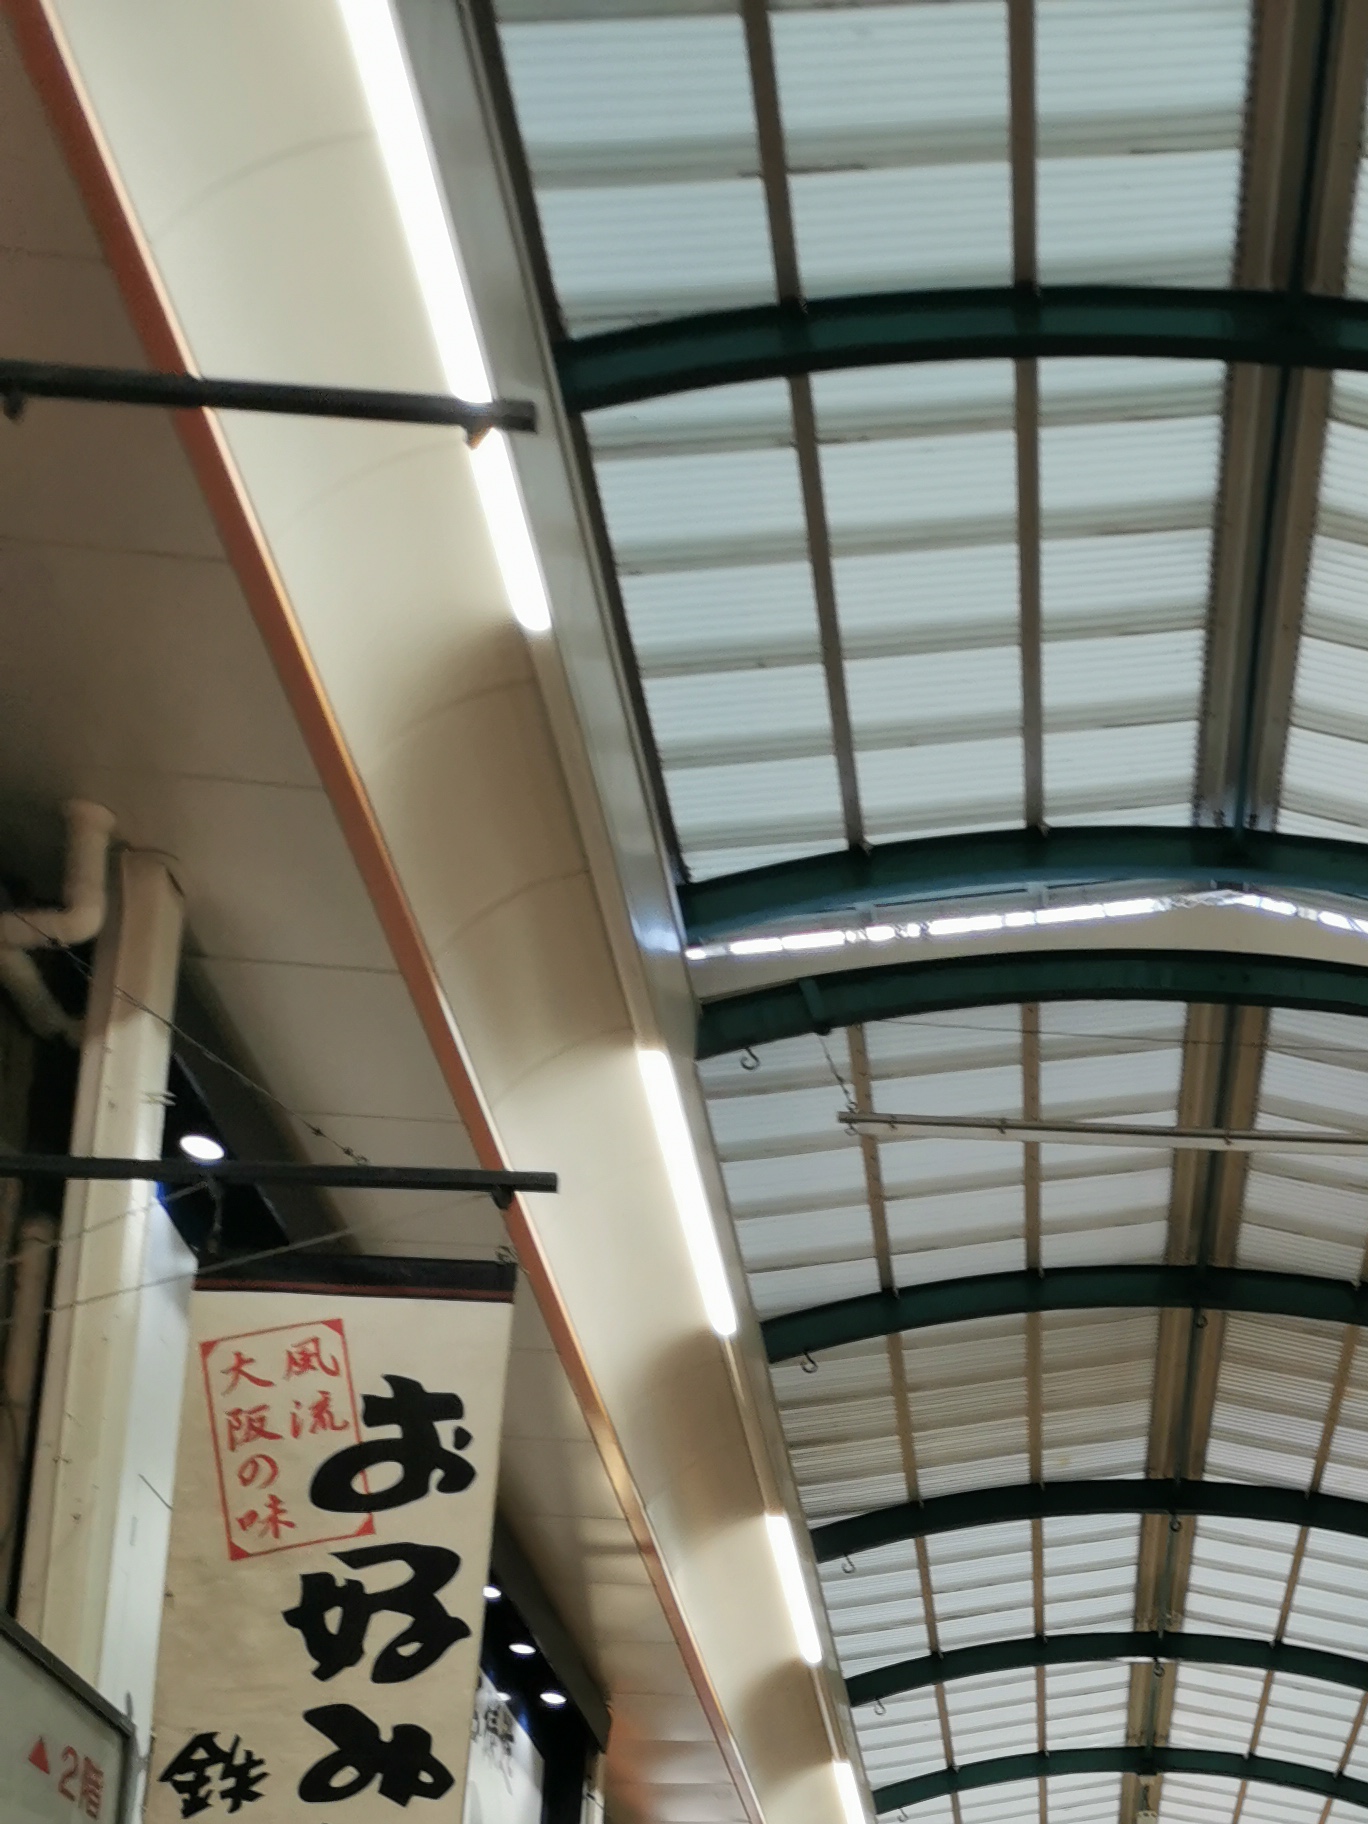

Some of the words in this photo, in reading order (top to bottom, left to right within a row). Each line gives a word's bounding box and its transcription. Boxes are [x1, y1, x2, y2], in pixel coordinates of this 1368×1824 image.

[221, 1352, 297, 1538] 大阪の味
[283, 1337, 349, 1438] 風流
